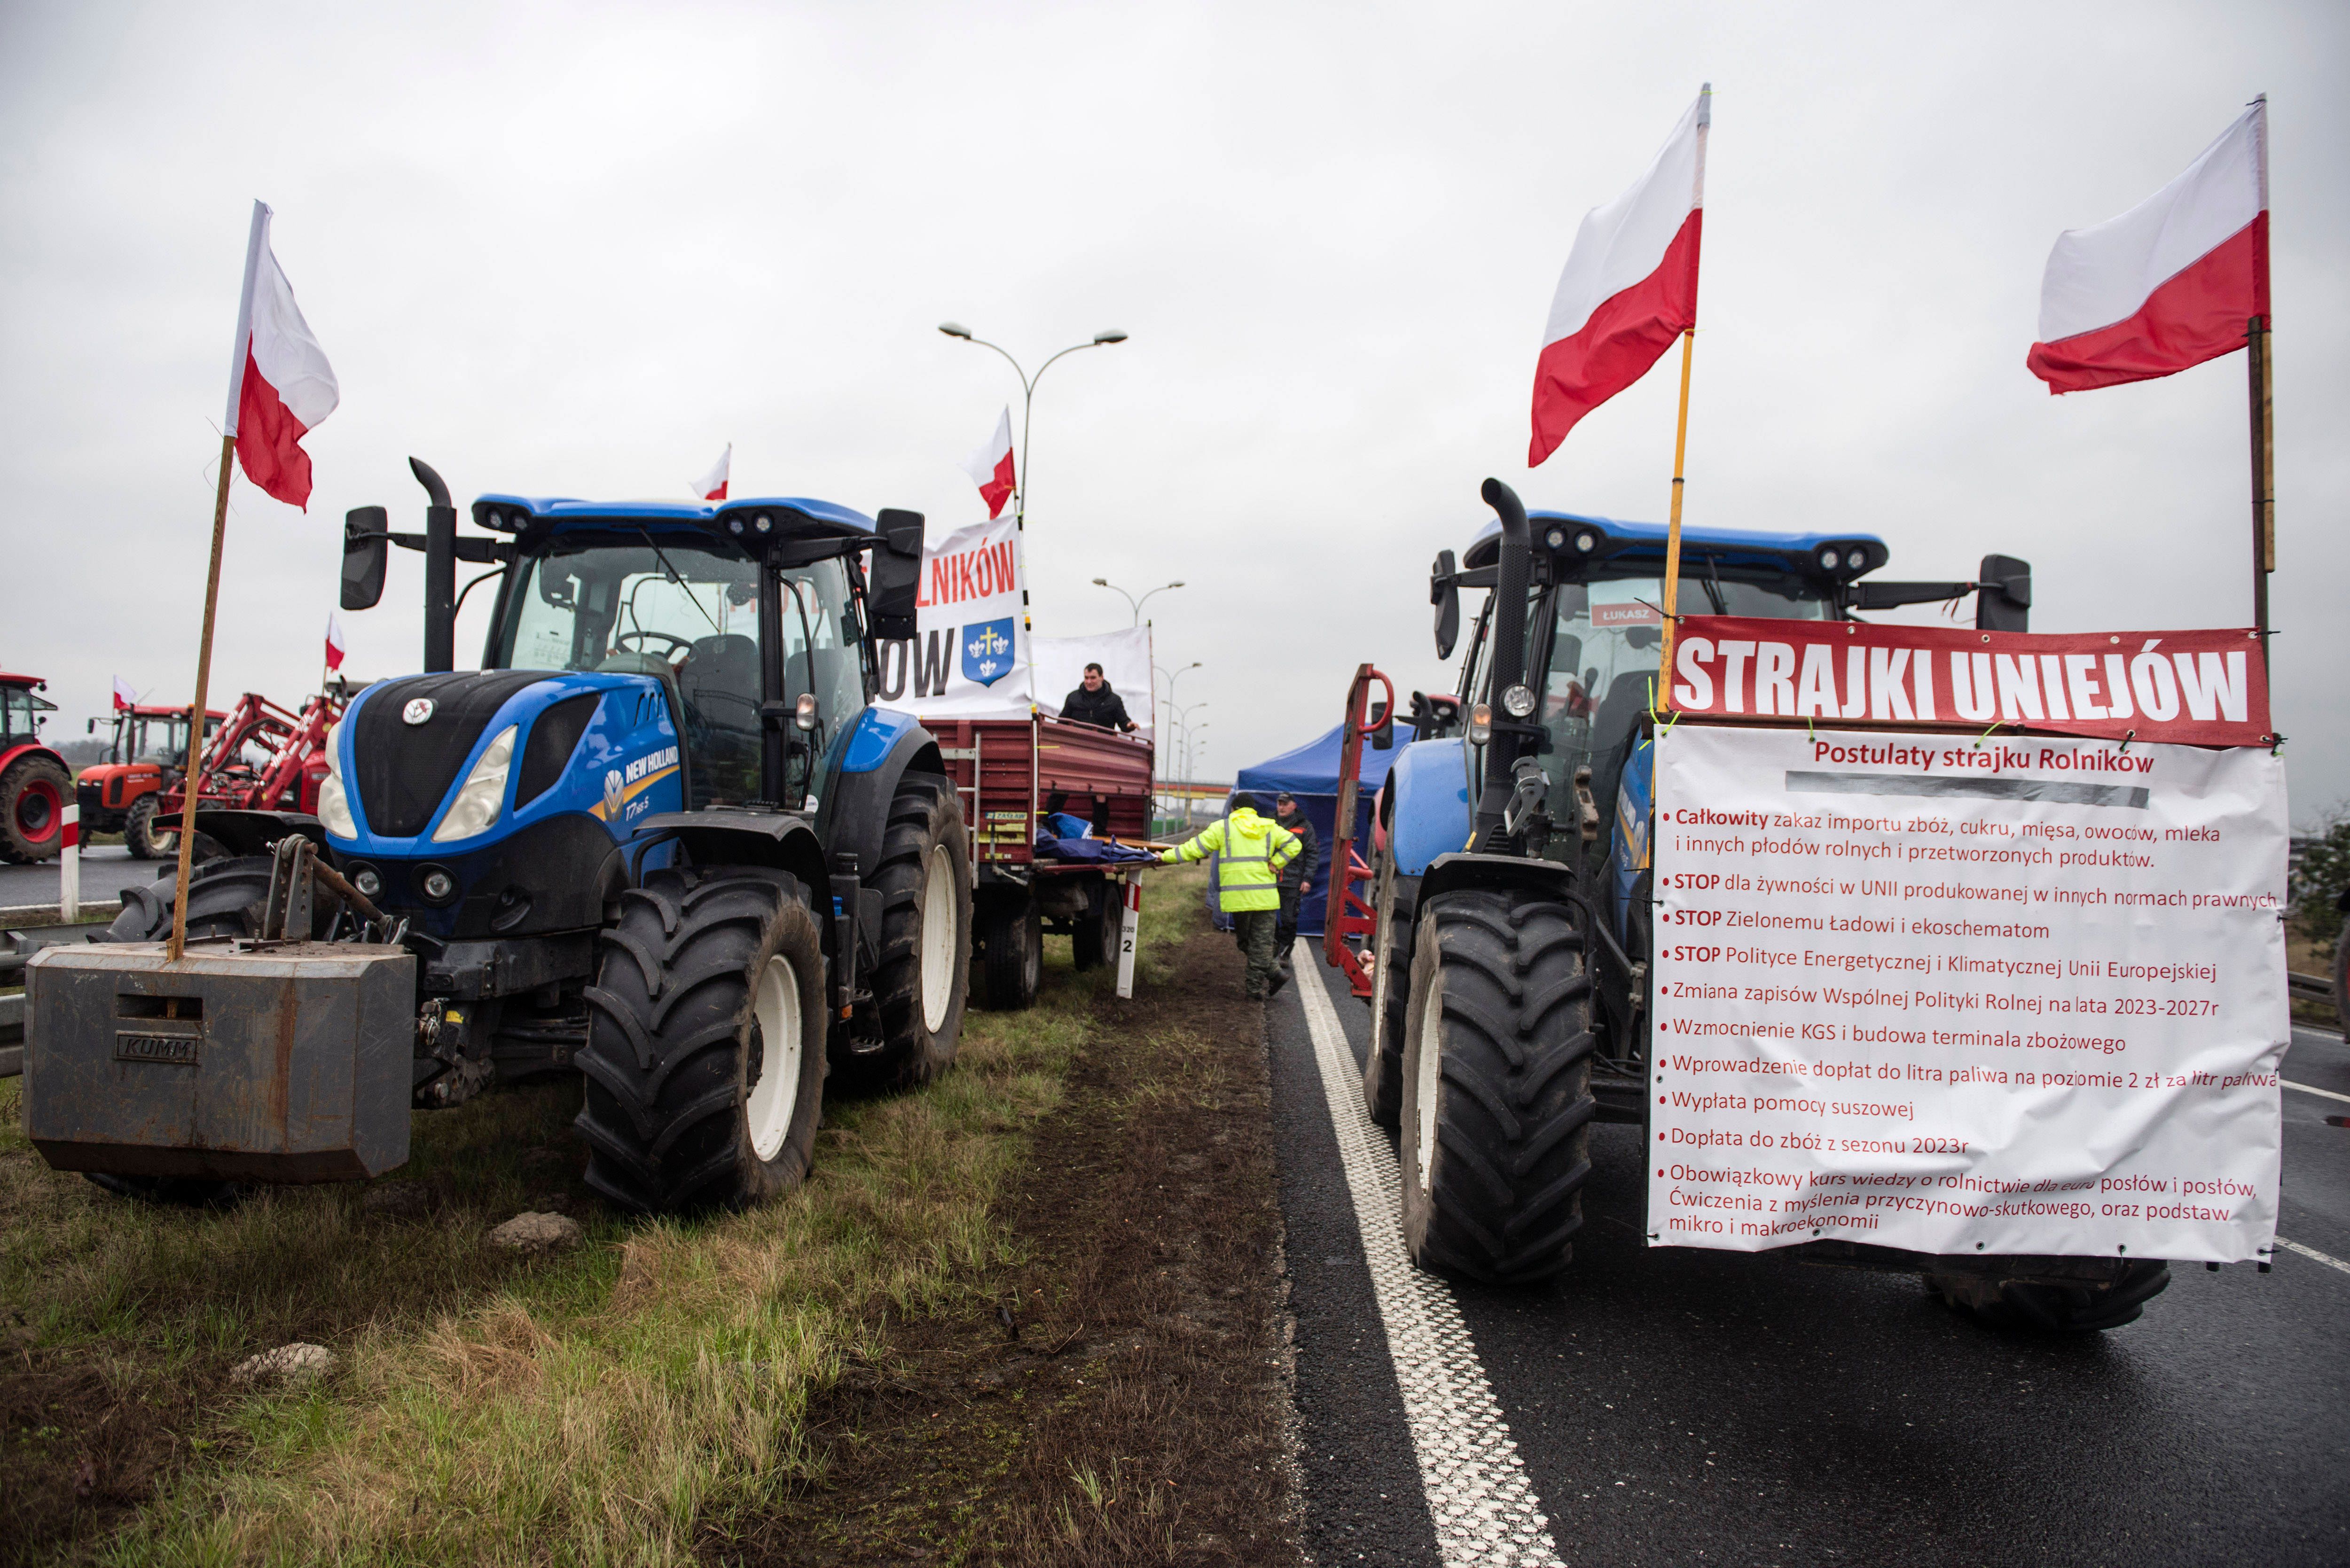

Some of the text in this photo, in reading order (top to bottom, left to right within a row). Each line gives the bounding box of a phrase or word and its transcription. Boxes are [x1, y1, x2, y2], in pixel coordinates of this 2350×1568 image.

[916, 537, 1015, 608] LNIKÓW
[1603, 609, 1650, 621] ŁUKASZ
[1674, 637, 2248, 722] STRAJKI UNIEJÓW
[626, 746, 678, 783] NEW HOLLAND
[1815, 741, 2154, 773] Postulaty strajku Rolników
[1676, 808, 2219, 843] Całkowity zakaz importu zbóż, cukru, mięsa, owoców, mleka
[1676, 835, 2154, 867] i innych płodów rolnych i przetworzonych produktów.
[1674, 873, 2277, 911] STOP dla żywności w UNII produkowanej w innych normach prawnych
[1675, 910, 2049, 938] STOP Zielonemu Ładowi i ekoschematom
[1123, 940, 1132, 952] 2
[1674, 946, 2216, 983] STOP Polityce Energetycznej i Klimatycznej Unii Europejskiej
[1674, 982, 2218, 1016] Zmiana zapisów Wspólnej Polityki Rolnej na lata 2023-2027r
[125, 1038, 191, 1057] KUMM
[1674, 1019, 2125, 1054] Wzmocnienie KGS i budowa terminala zbożowego
[1673, 1054, 2276, 1091] Wprowadzenie dopłat do litra paliwa na poziomie 2 zł za litr paliwa
[1672, 1091, 1913, 1121] Wypłata pomocy suszowej
[1672, 1128, 1969, 1154] Dopłata do zbóż z sezonu 2023r
[1670, 1164, 2256, 1200] Obowiązkowy kurs wiedzy o rolnictwie dla euro posłów i posłów,
[1669, 1186, 2229, 1222] Ćwiczenia z myślenia przyczynowo-skutkowego, oraz podstaw
[1669, 1214, 1879, 1237] mikro i makroekonomii
